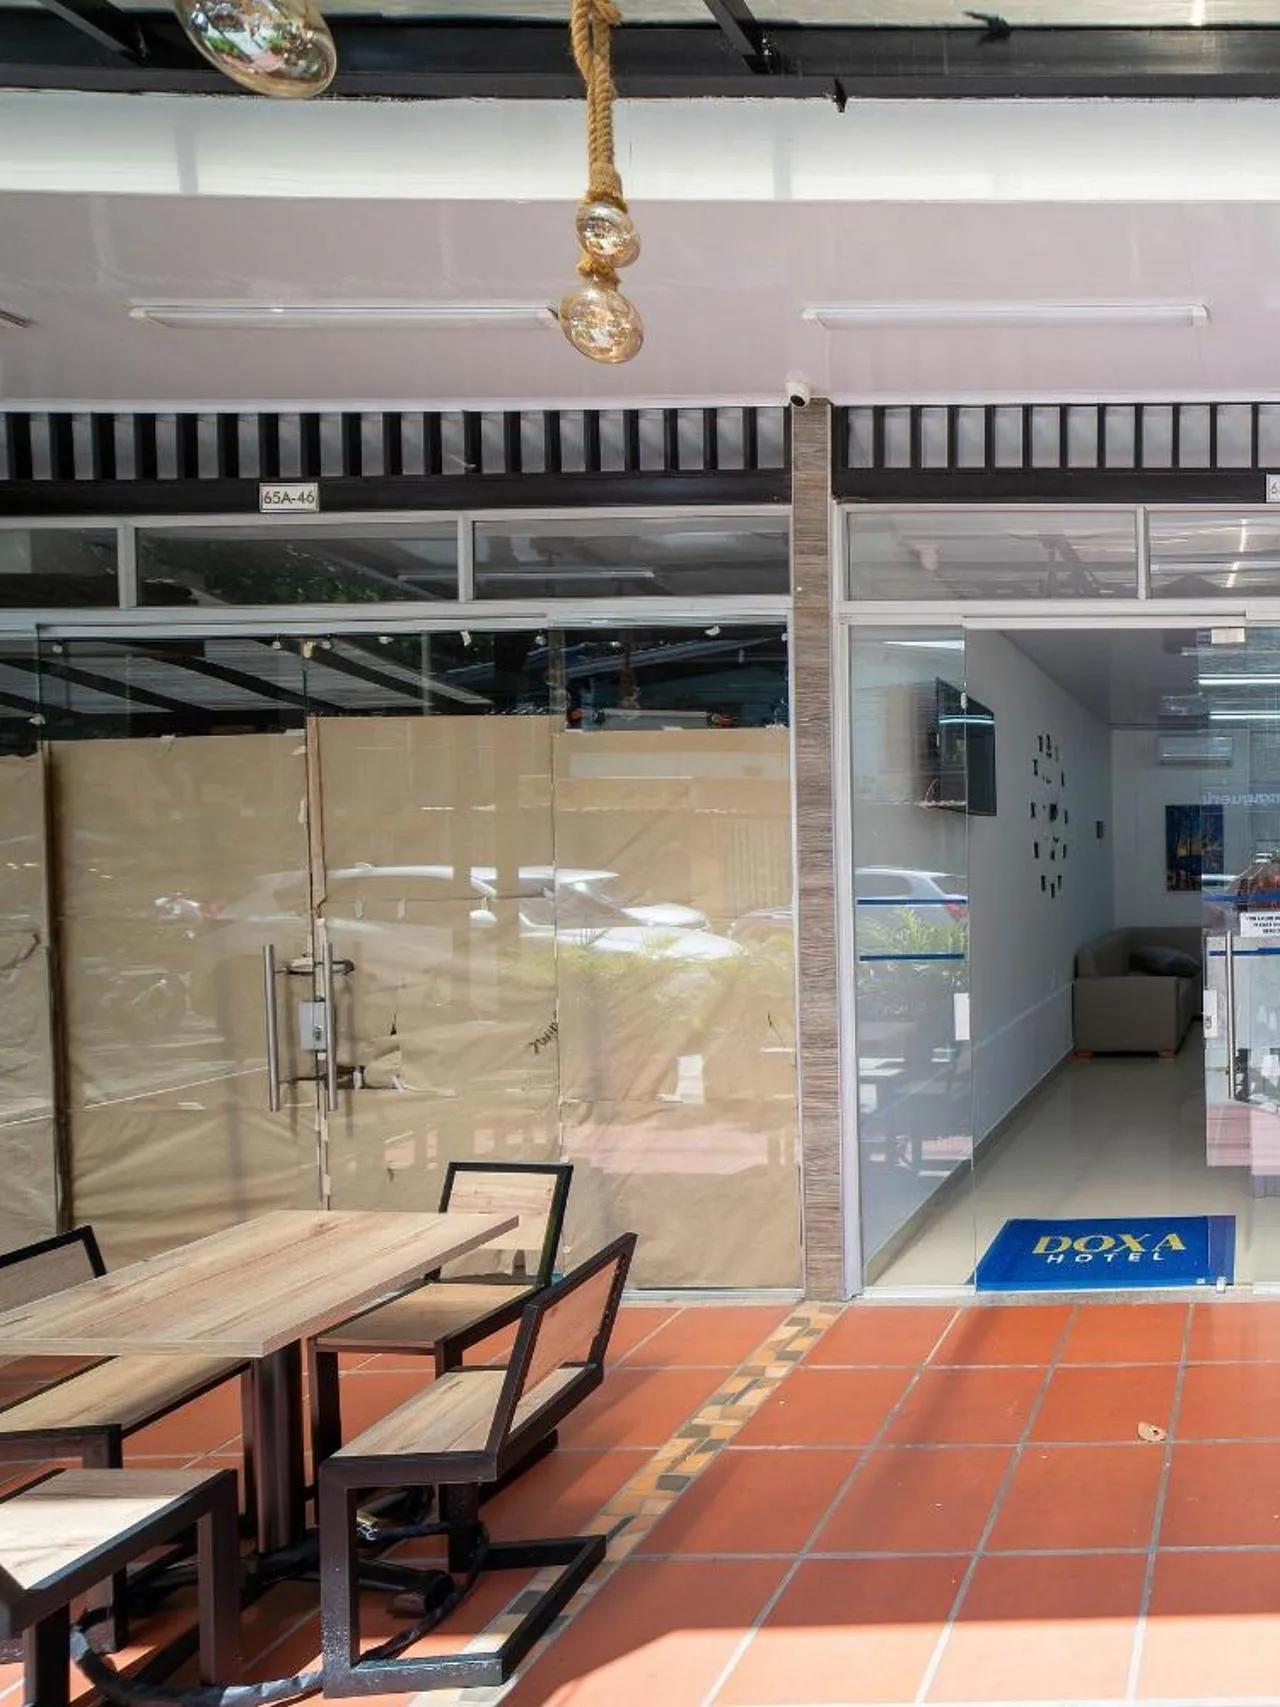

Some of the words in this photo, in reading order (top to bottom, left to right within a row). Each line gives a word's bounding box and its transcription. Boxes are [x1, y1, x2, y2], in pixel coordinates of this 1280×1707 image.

[263, 491, 315, 505] 65A-46
[1032, 1233, 1187, 1254] DOXA
[1046, 1252, 1166, 1264] HOTEL
